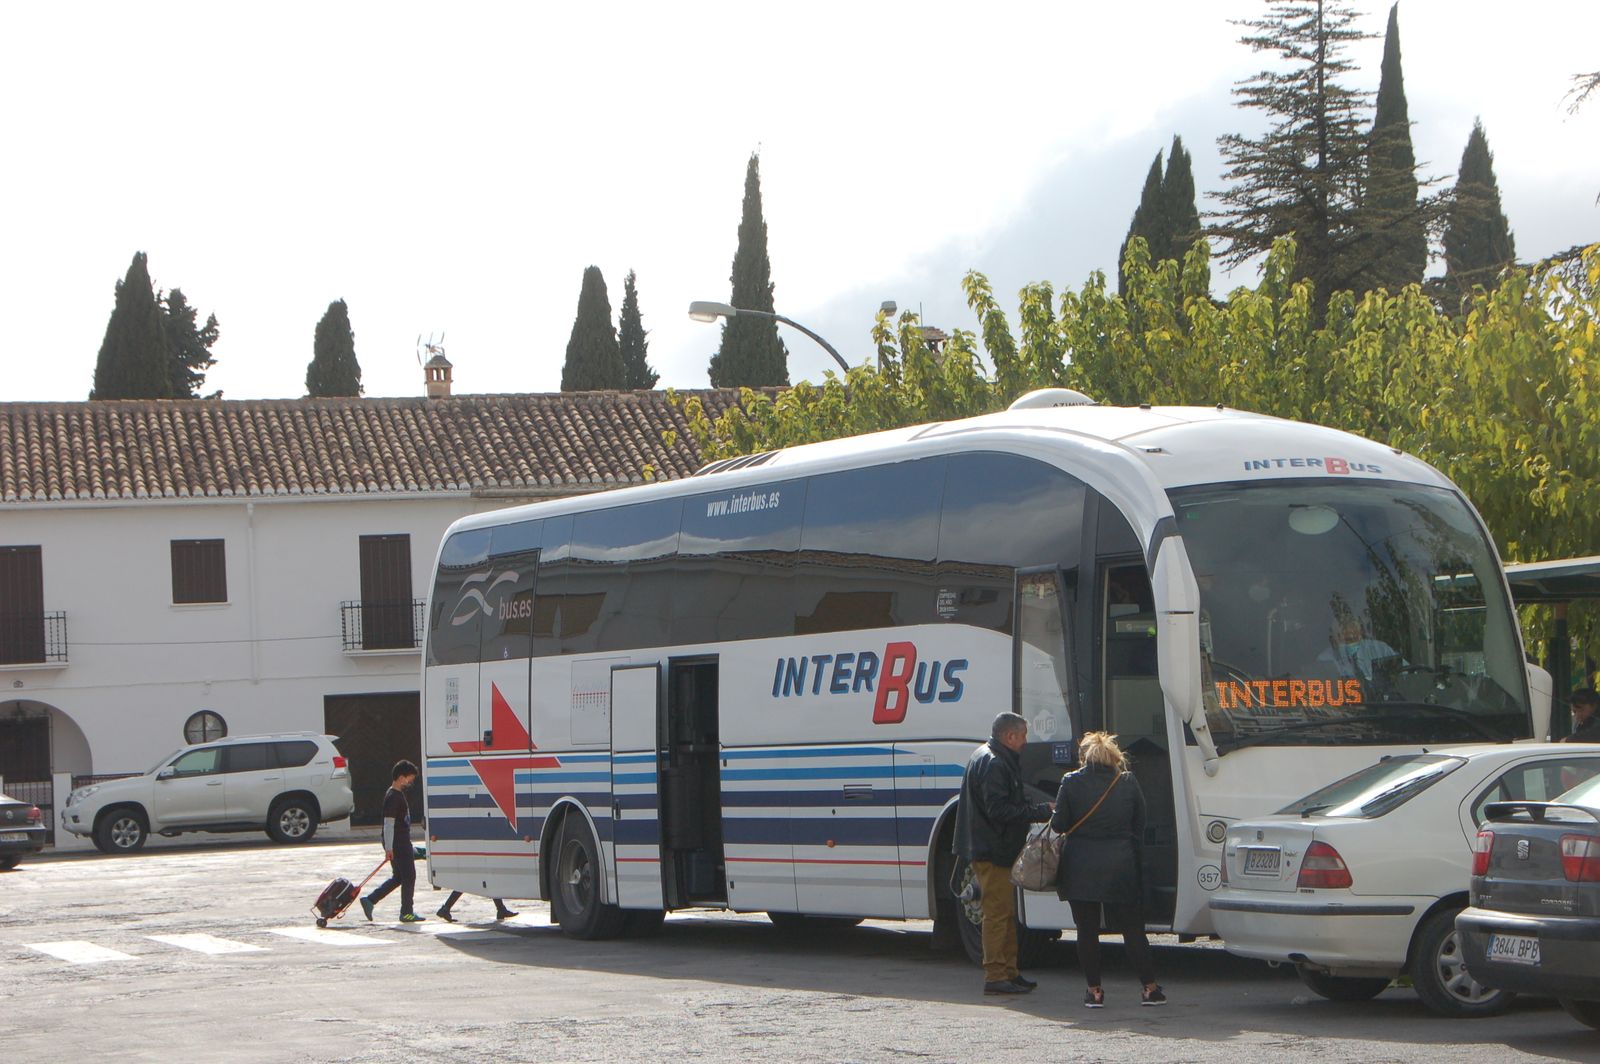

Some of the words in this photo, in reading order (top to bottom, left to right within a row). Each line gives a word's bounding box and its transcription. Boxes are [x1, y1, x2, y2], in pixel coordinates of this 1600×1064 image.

[1244, 457, 1383, 475] INTERBUS
[706, 491, 781, 518] www.interbus.es
[771, 641, 969, 725] INTERBUS
[1215, 679, 1362, 709] INTERBUS
[1200, 872, 1219, 883] 357
[1493, 936, 1516, 955] 3844
[1517, 939, 1539, 959] BPB
